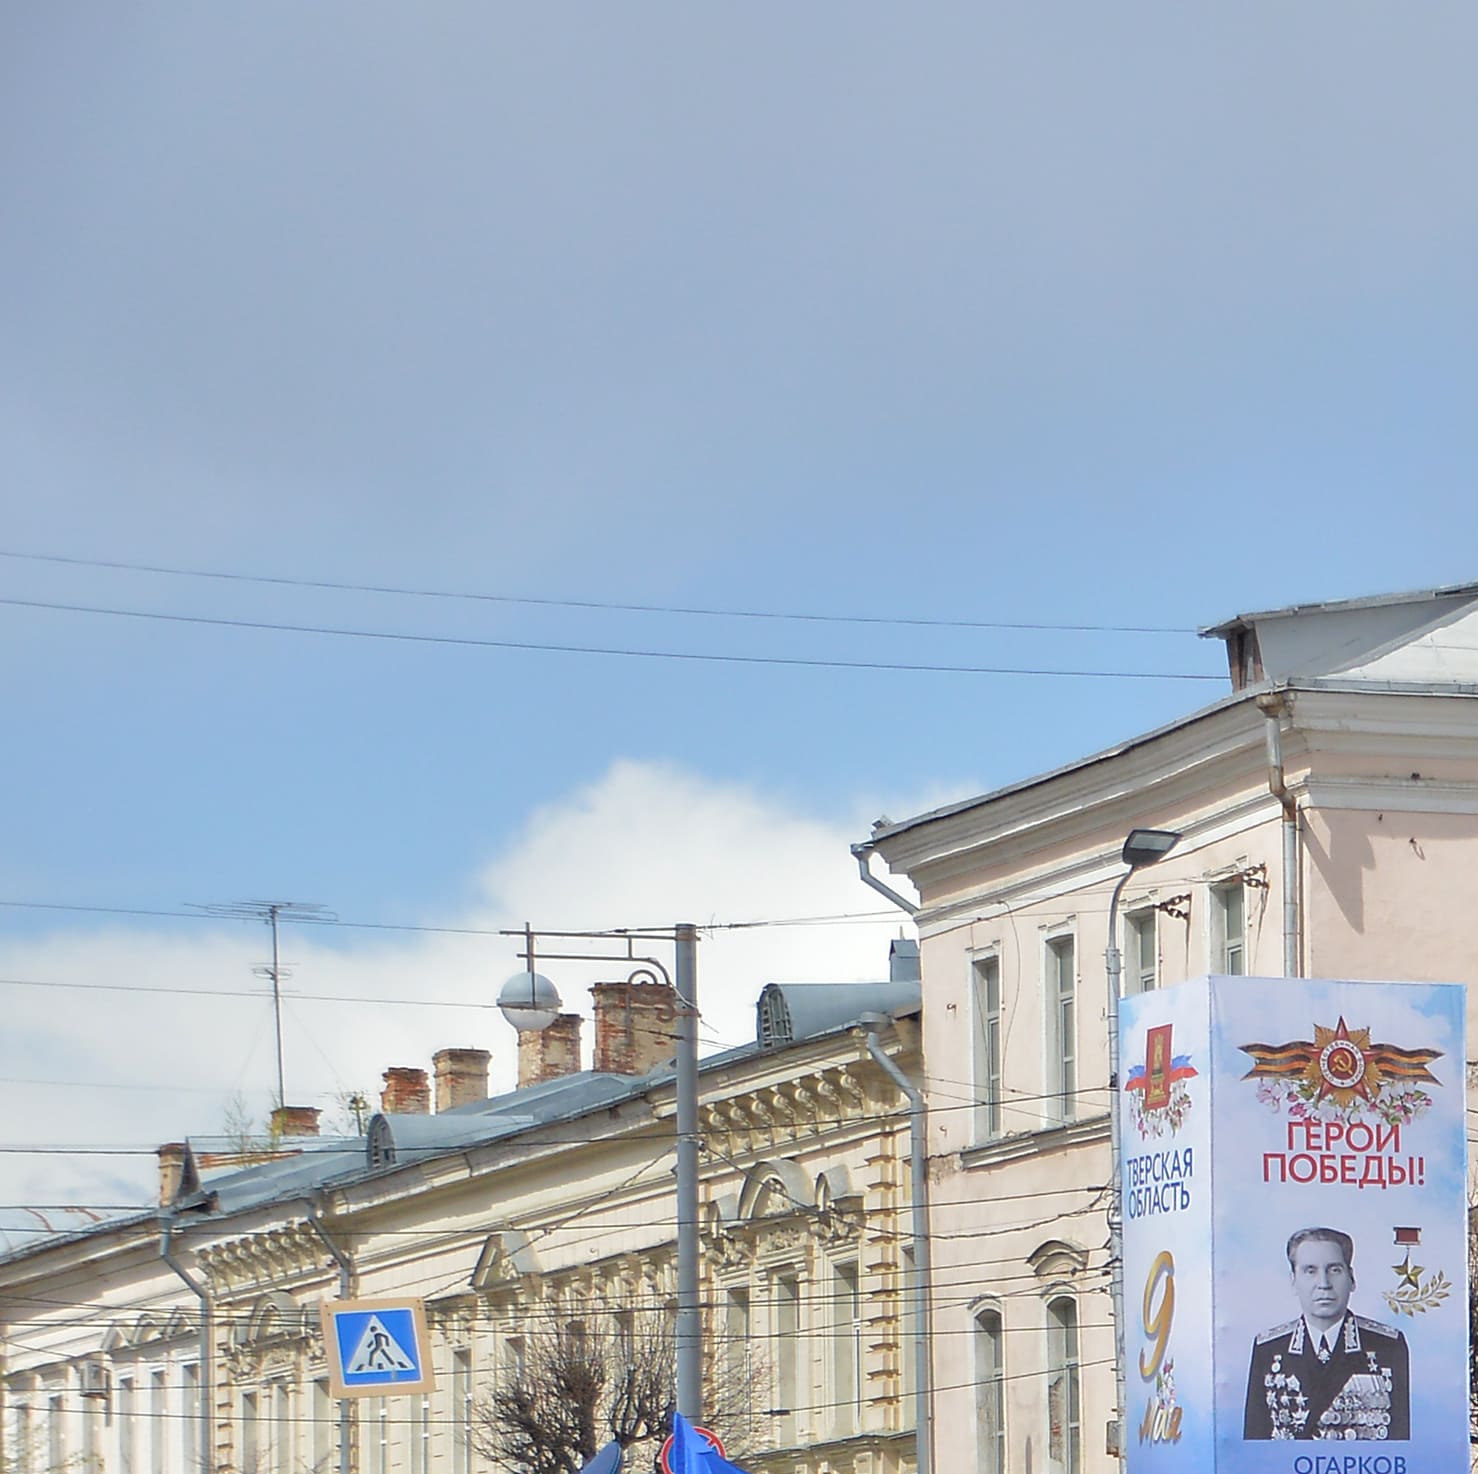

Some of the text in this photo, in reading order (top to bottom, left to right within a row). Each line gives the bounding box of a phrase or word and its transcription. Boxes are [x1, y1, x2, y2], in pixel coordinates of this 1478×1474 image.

[1288, 1121, 1400, 1152] ГЕРОИ
[1127, 1147, 1193, 1189] ТВЕРСКАЯ
[1263, 1153, 1425, 1189] ПОБЕДЫ!
[1129, 1181, 1190, 1219] ОБЛАСТЬ
[1139, 1250, 1175, 1382] 9
